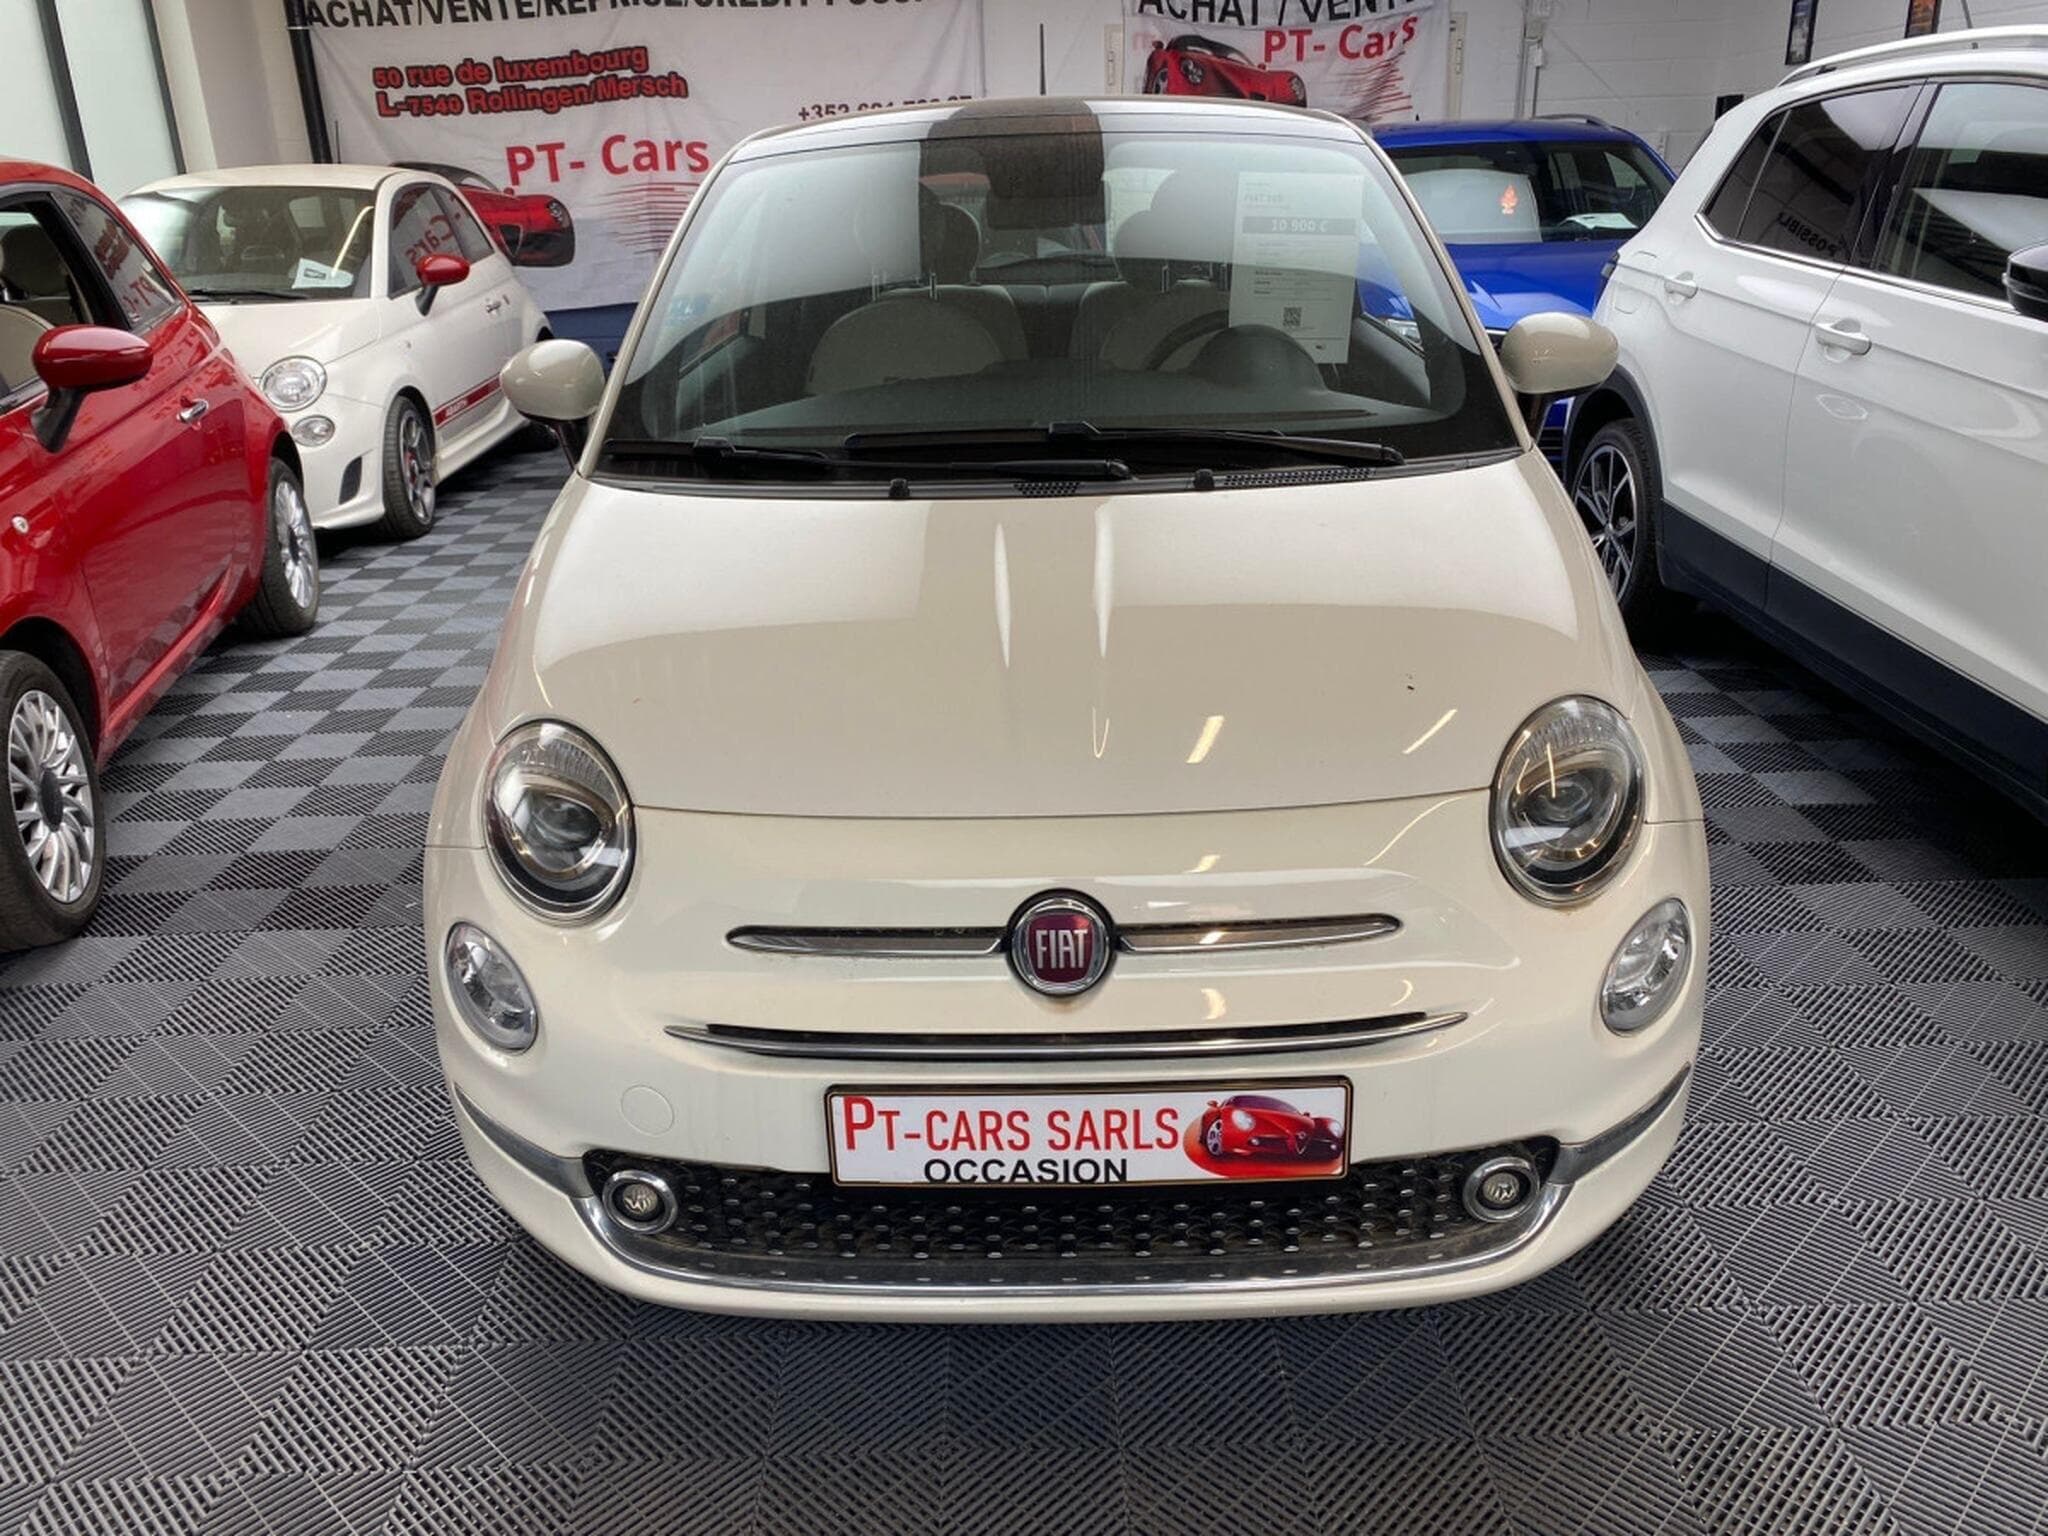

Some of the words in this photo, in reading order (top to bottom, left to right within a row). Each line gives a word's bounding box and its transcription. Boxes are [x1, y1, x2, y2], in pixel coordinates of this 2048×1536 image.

[1264, 28, 1326, 63] PT-
[1338, 16, 1418, 60] Cars
[373, 67, 403, 88] 50
[406, 65, 453, 87] rue
[455, 58, 492, 84] de
[493, 46, 648, 83] luxembourg
[376, 91, 464, 117] L-7540
[466, 72, 689, 114] Rollingen/Mersch
[505, 142, 586, 187] PT-
[601, 134, 710, 175] Cars
[1035, 929, 1088, 969] FIAT
[843, 1096, 1031, 1151] PT-CARS
[1046, 1107, 1179, 1150] SARLS
[923, 1157, 1128, 1184] OCCASION
